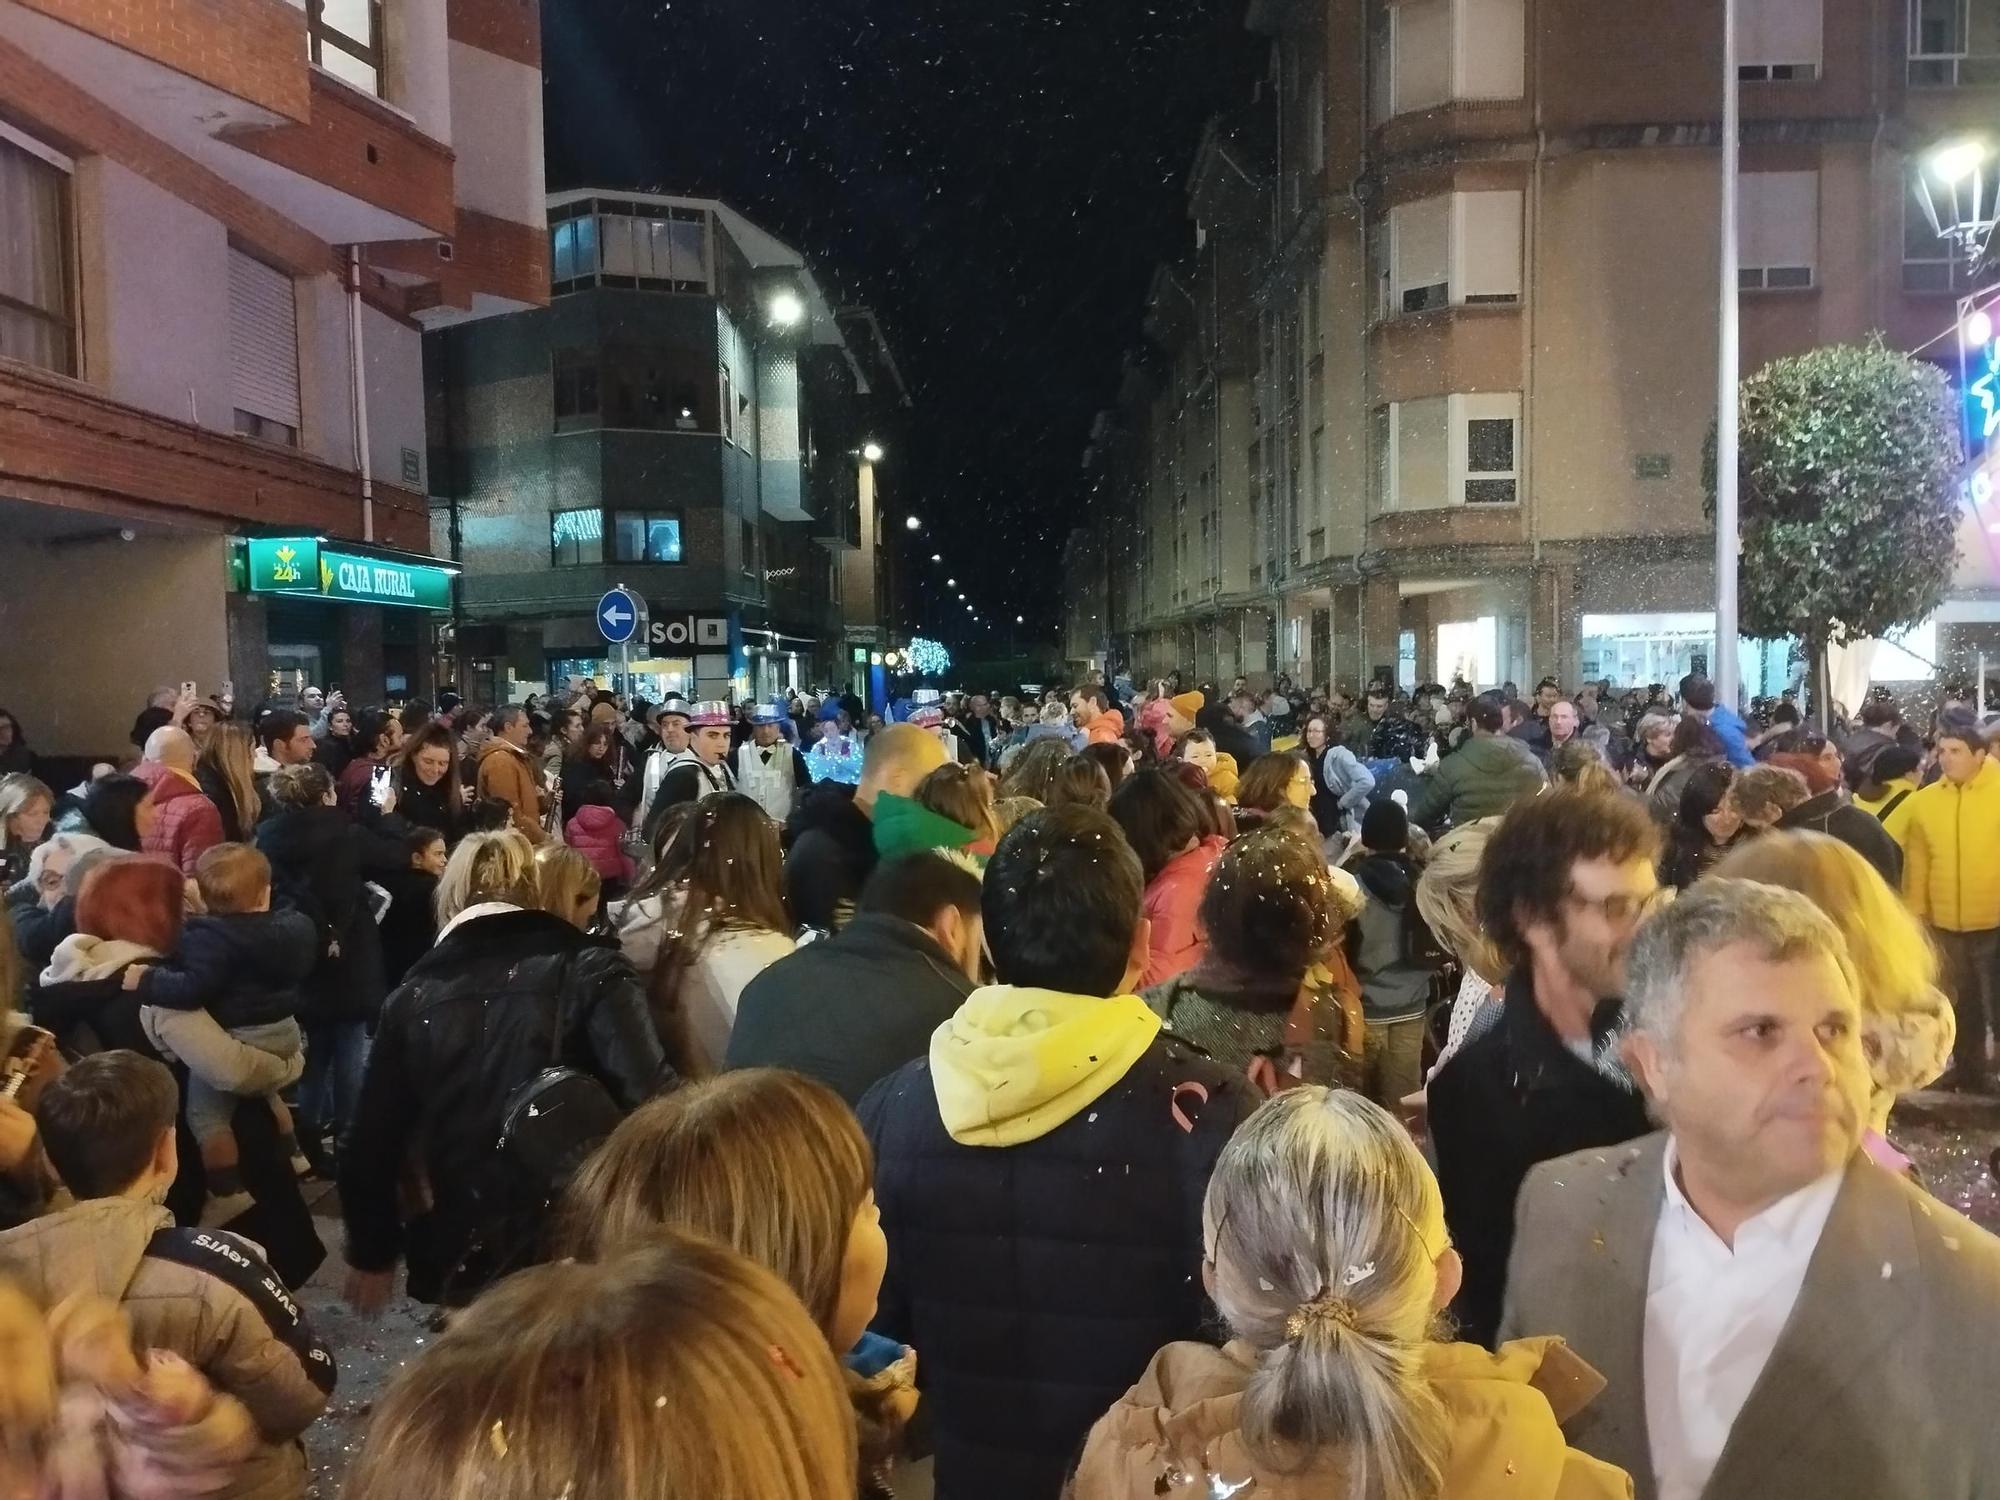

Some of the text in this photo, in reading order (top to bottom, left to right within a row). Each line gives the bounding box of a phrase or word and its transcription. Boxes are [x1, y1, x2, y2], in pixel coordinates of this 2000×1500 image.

[273, 566, 301, 582] 24h
[339, 562, 416, 598] CAJA RURAL
